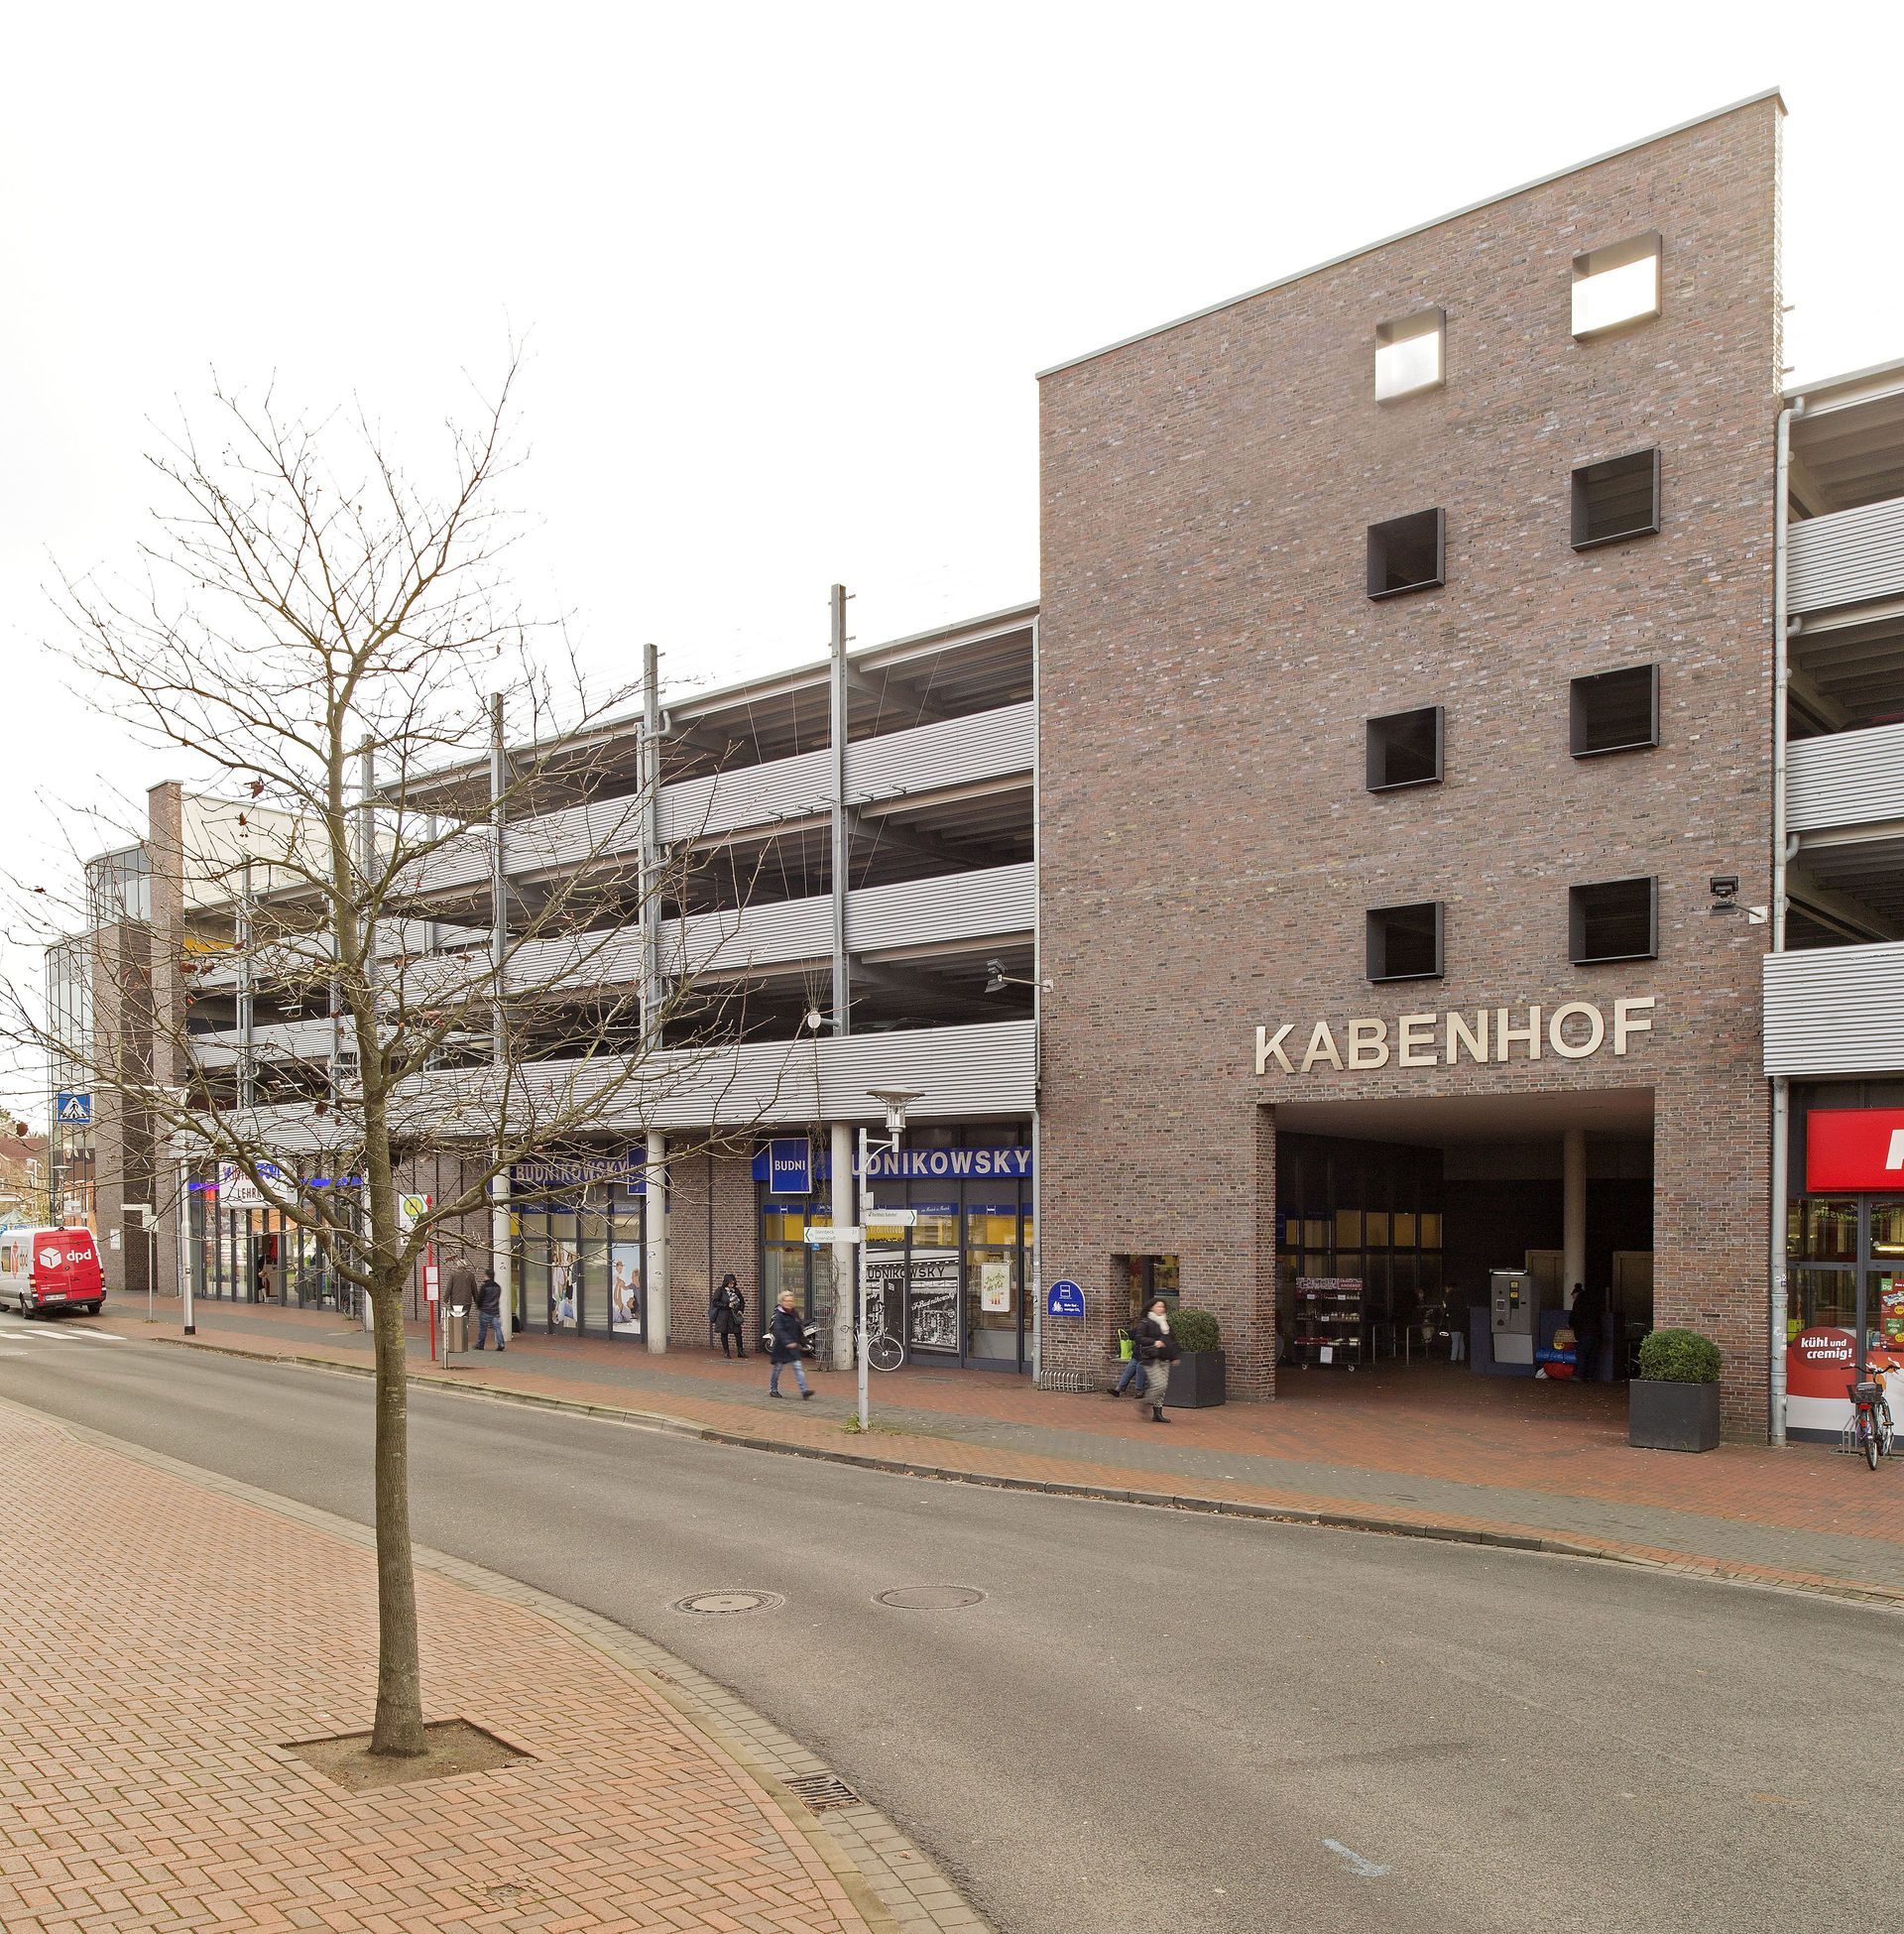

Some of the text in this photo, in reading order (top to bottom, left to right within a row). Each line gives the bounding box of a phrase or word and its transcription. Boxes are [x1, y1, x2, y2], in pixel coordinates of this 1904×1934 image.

[1255, 997, 1655, 1075] KABENHOF
[774, 1160, 805, 1171] BUDNI
[852, 1149, 1030, 1175] UDNIKOWSKY
[66, 1249, 92, 1263] dpd
[867, 1267, 945, 1278] UDNIKOWSKY
[1801, 1336, 1846, 1348] kühl und
[1807, 1347, 1852, 1360] cremig!
